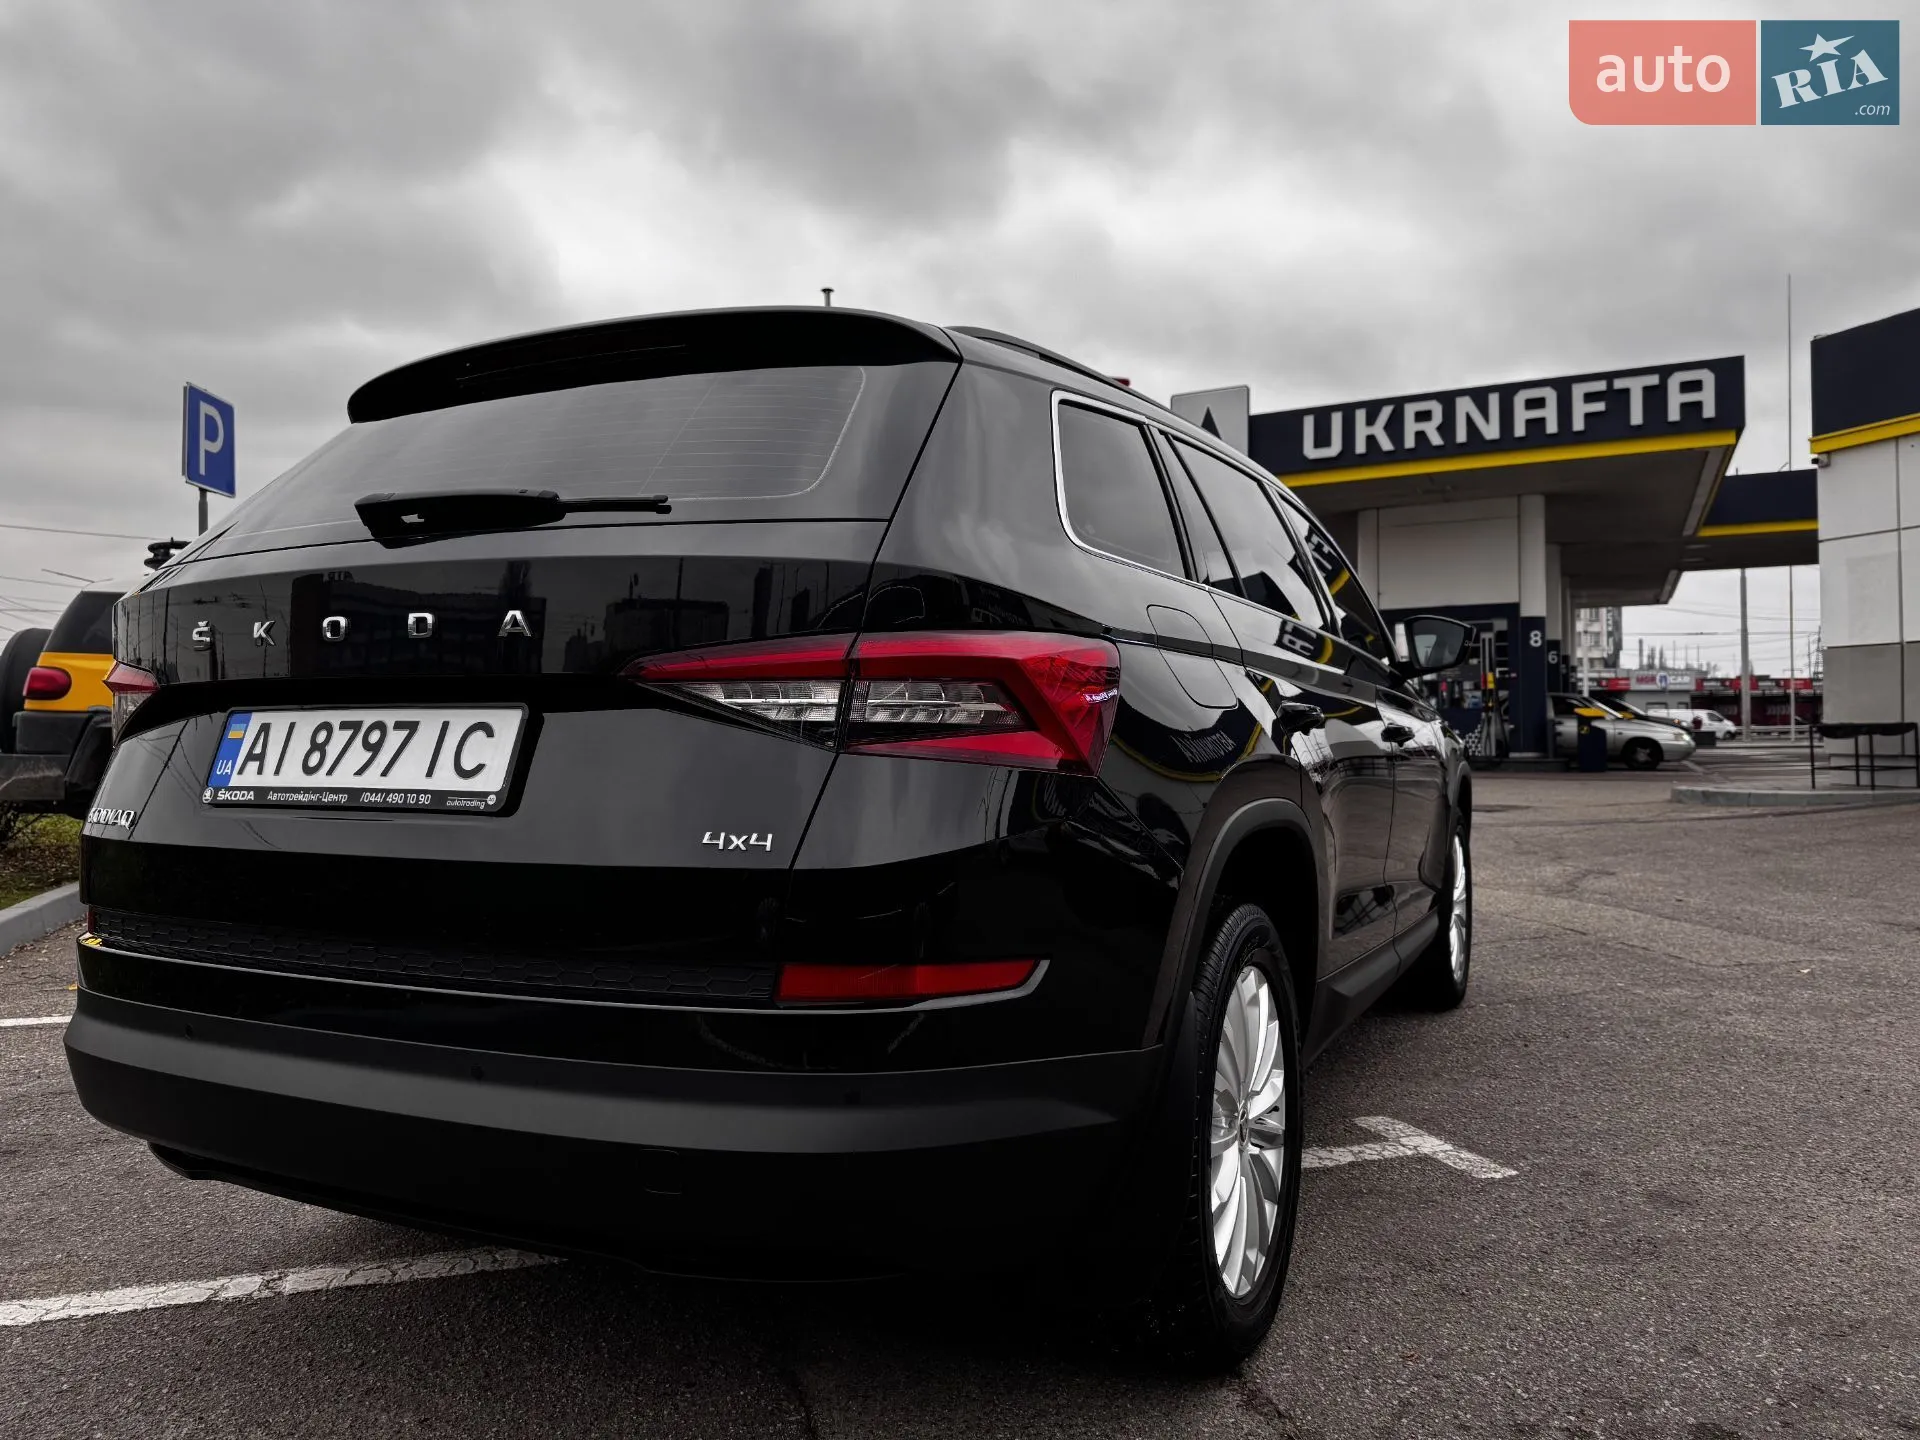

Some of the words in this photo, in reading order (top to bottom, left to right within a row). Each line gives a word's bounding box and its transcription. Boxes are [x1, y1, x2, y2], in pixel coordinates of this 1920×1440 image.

[1302, 368, 1716, 460] UKRNAFTA
[198, 400, 225, 476] P
[1529, 630, 1542, 647] 8
[1548, 651, 1558, 664] 6
[236, 721, 297, 776] AI
[301, 720, 421, 777] 8797
[425, 720, 496, 780] IC
[216, 759, 232, 776] UA
[216, 788, 255, 801] ŠKODA
[267, 790, 348, 804] Автотрейдінг-Центр
[386, 793, 405, 804] 490
[406, 793, 417, 804] 10
[418, 794, 432, 805] 90
[701, 831, 773, 852] 4x4
